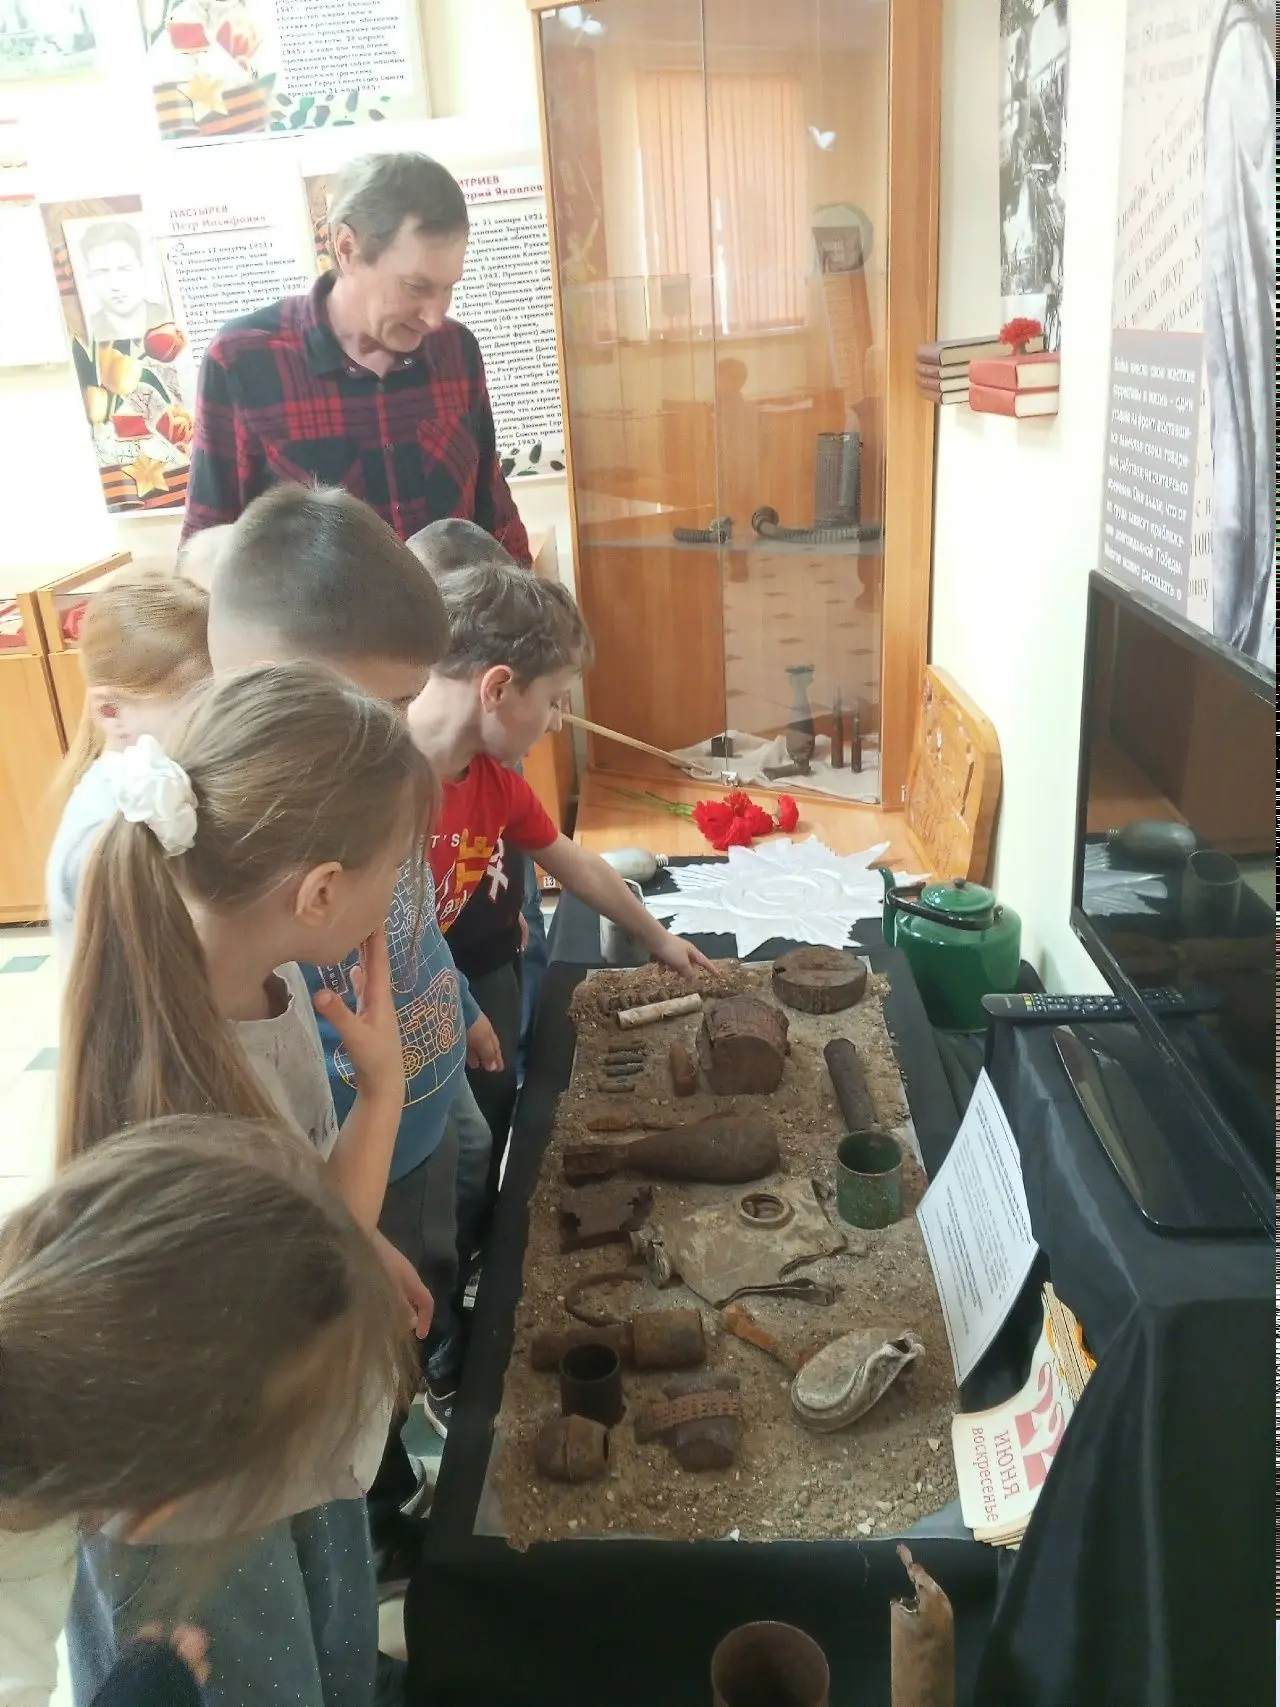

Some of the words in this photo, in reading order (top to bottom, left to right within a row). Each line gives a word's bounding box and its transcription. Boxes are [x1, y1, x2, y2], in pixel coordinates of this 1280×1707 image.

[170, 204, 228, 220] ПАСТЫРЕВ
[545, 877, 555, 888] 13
[972, 1427, 999, 1522] воскресенье
[993, 1429, 1020, 1500] ИЮНЯ
